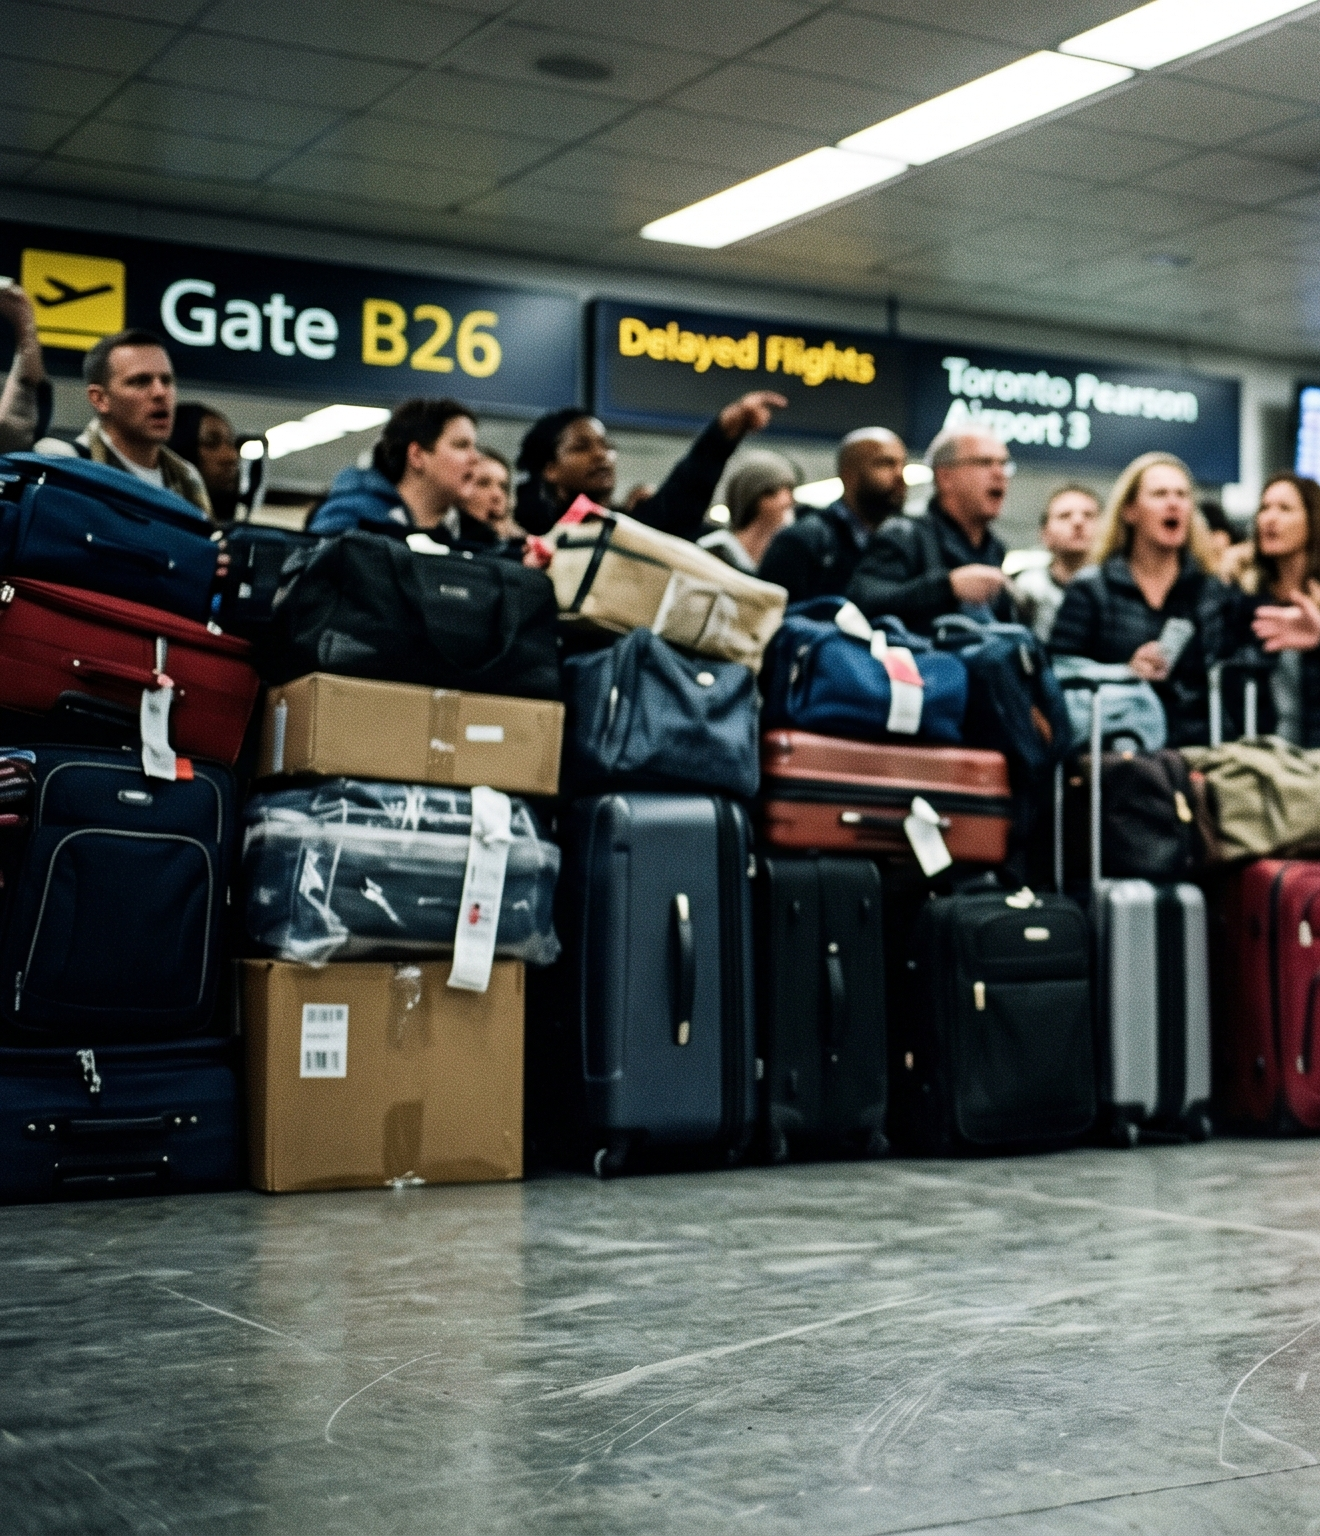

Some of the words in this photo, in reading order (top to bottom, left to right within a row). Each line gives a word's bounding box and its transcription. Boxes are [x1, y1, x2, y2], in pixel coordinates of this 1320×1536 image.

[160, 278, 339, 360] Gate
[361, 297, 502, 378] B26
[618, 316, 760, 373] Delayed
[765, 334, 877, 387] Flights
[941, 356, 1073, 409] Toronto
[1075, 372, 1199, 424] Pearson
[1065, 410, 1092, 450] 3
